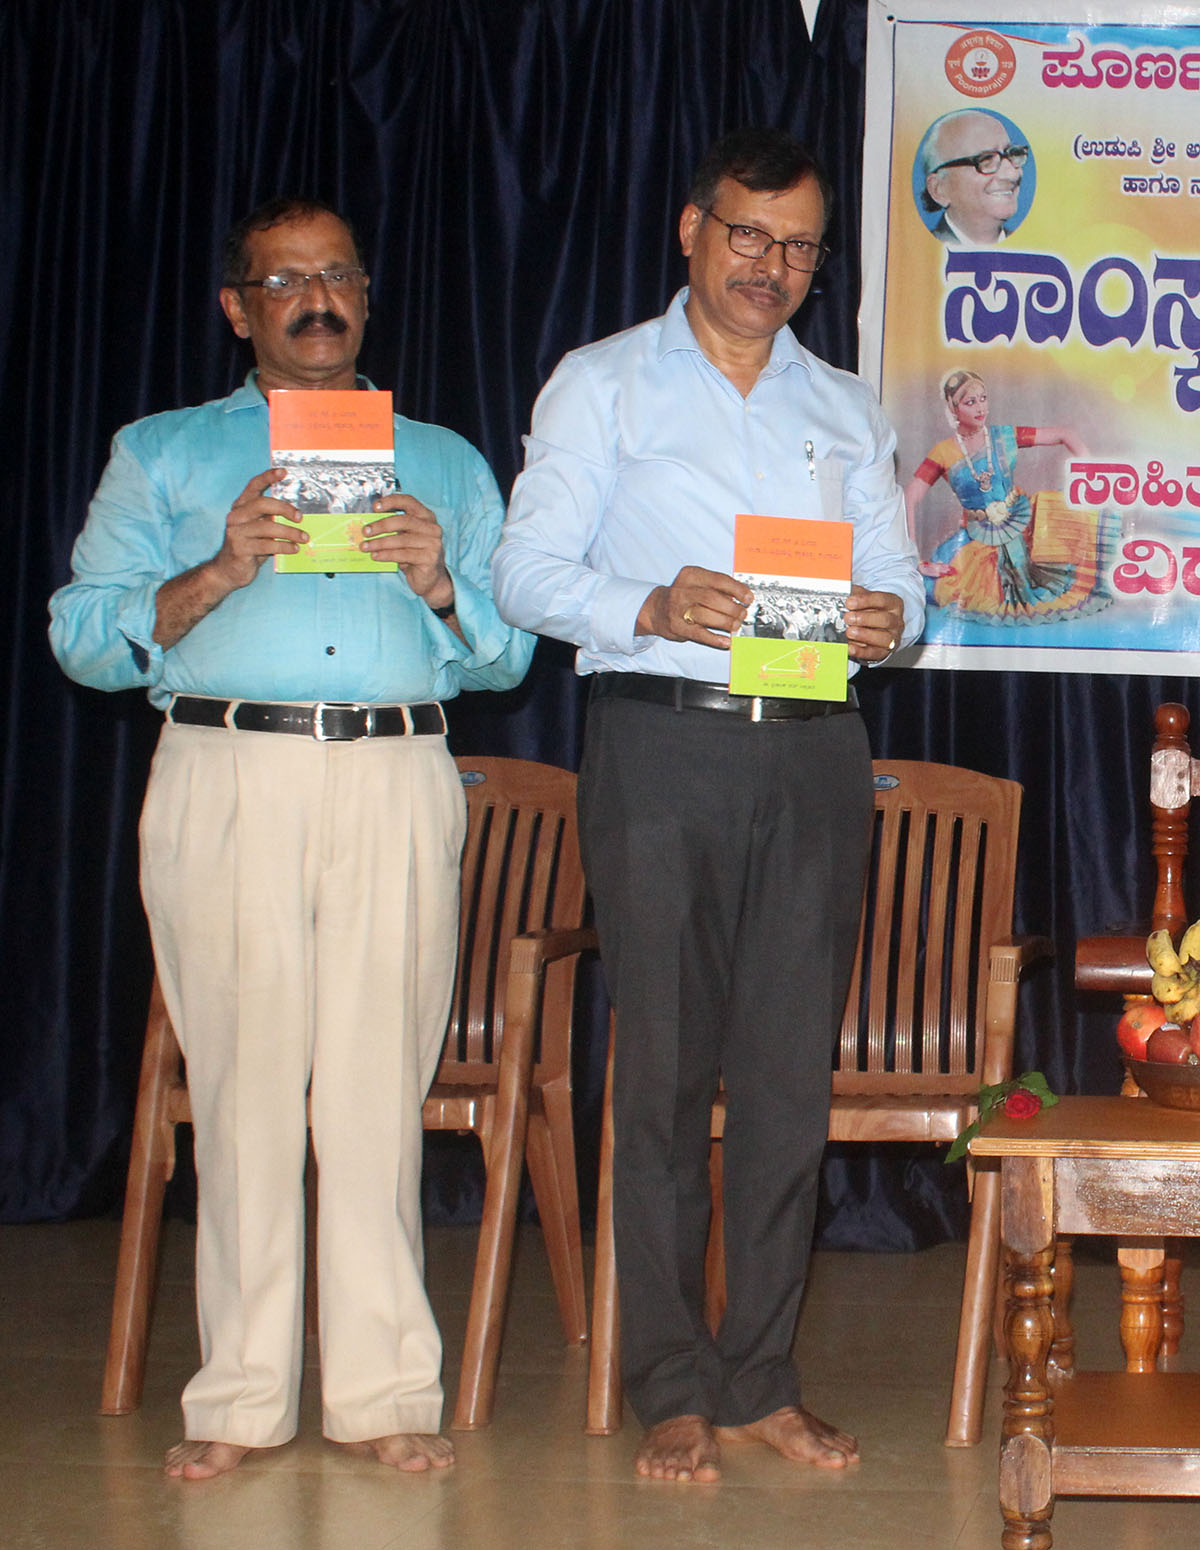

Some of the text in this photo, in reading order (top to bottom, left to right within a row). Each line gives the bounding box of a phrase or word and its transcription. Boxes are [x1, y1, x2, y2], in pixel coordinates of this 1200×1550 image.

[1073, 135, 1142, 160] (ಉಡುಪಿ
[1151, 137, 1176, 164] ಶ್ರೀ
[1123, 172, 1180, 193] ಹಾಗೂ
